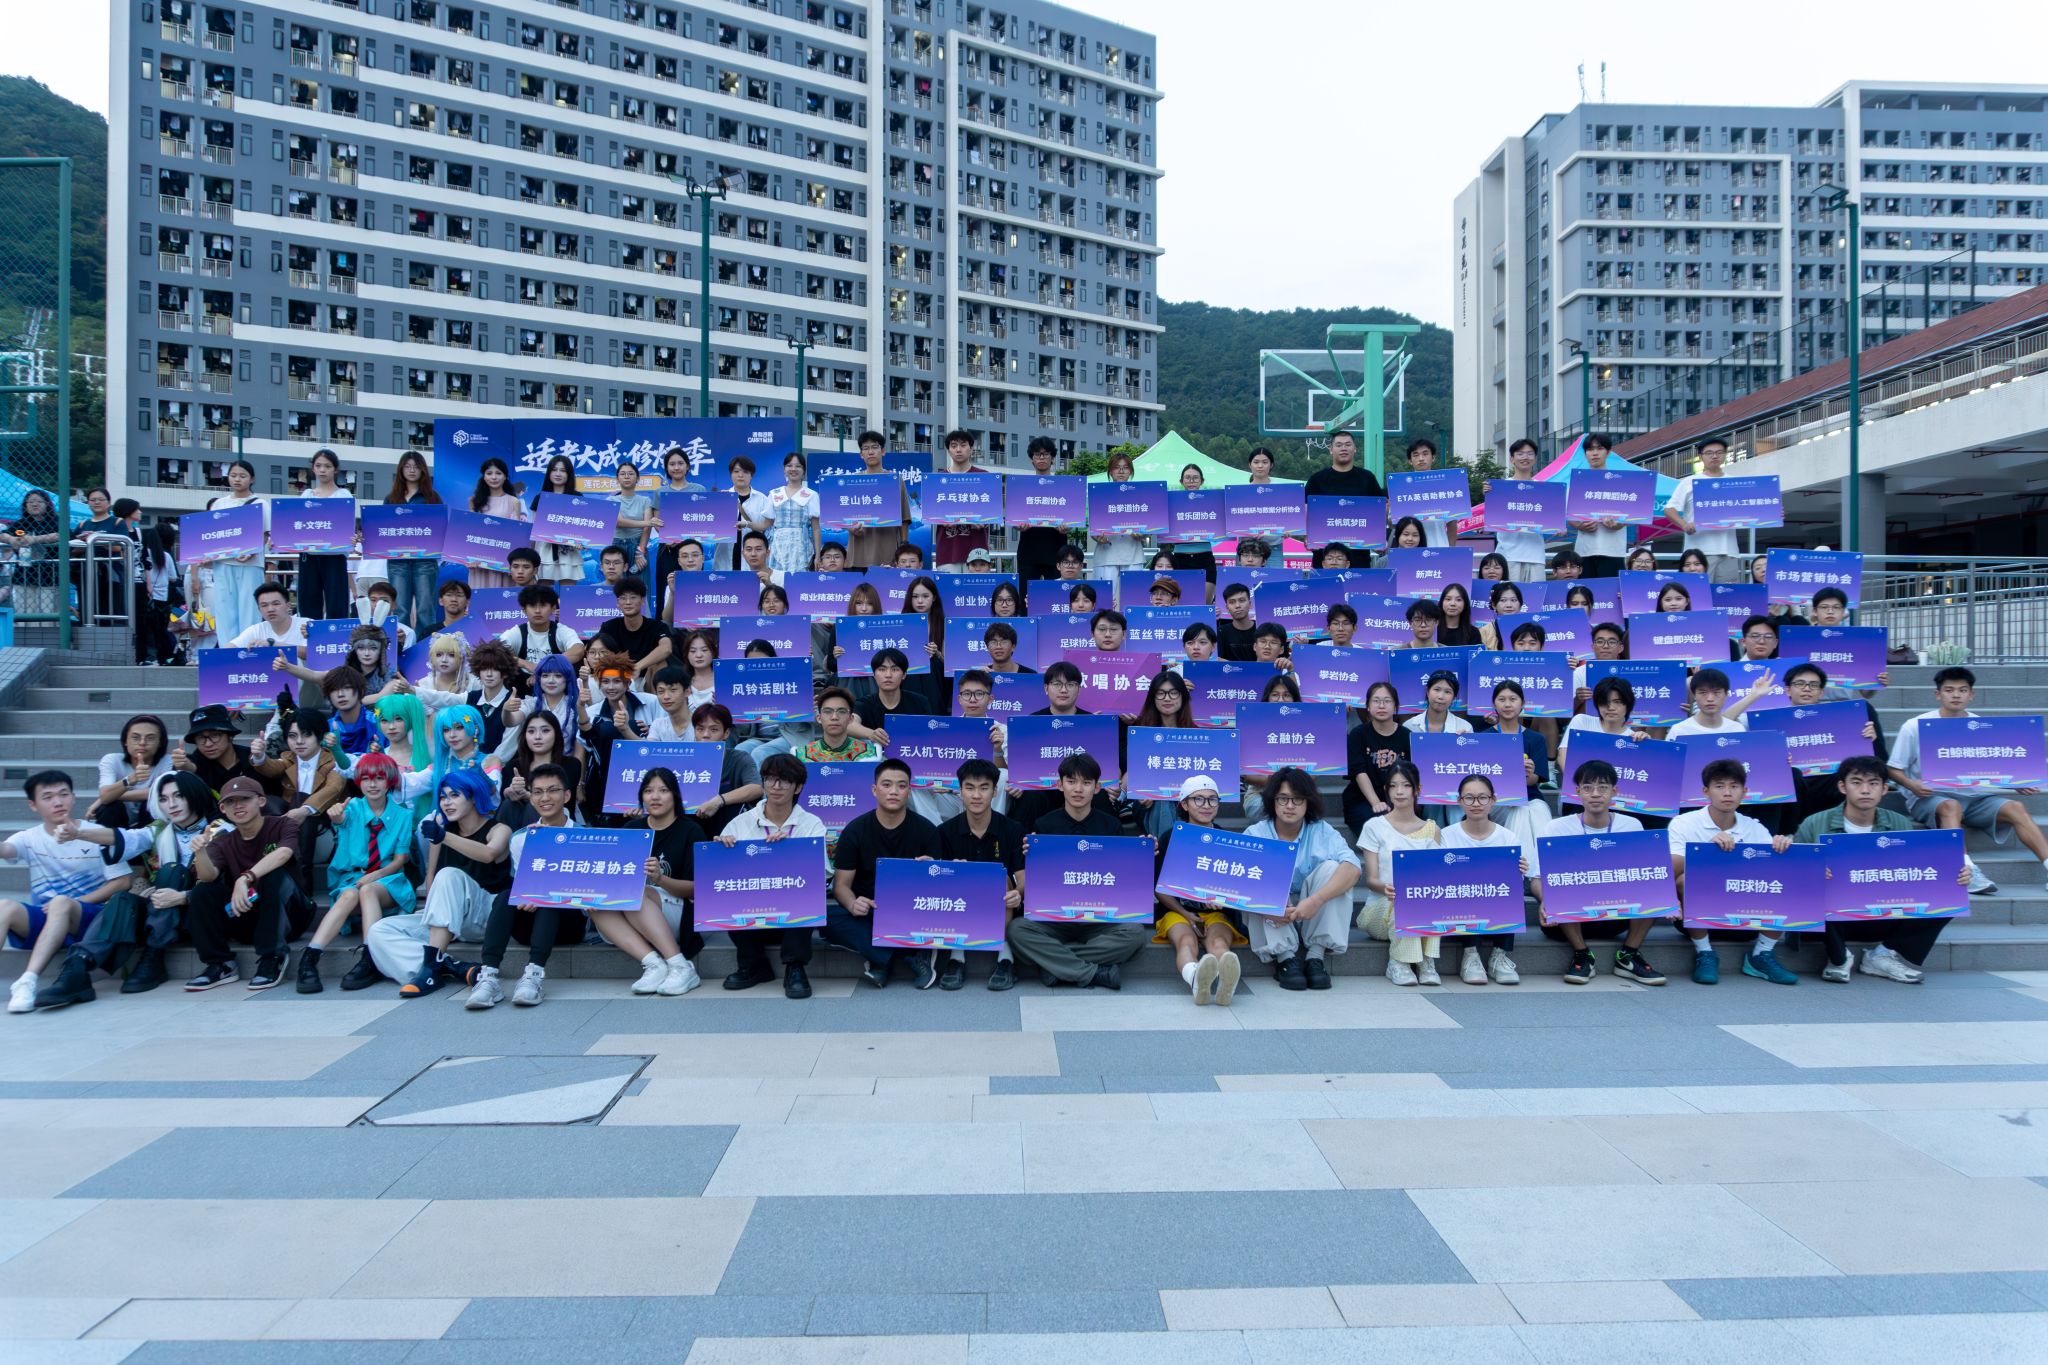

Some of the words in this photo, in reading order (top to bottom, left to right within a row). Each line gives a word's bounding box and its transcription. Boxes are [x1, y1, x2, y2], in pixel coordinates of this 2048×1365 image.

[840, 495, 882, 505] 登山协会
[937, 493, 989, 502] 乒乓球协会
[1026, 497, 1066, 505] 音乐剧协会
[1398, 490, 1463, 502] ETA英语助教协会
[1585, 491, 1637, 501] 体育舞蹈协会
[1508, 502, 1542, 511] 韩语协会
[1696, 498, 1779, 507] 电子设计与人工智能协会
[1108, 504, 1148, 513] 跆拳道协会
[547, 514, 604, 528] 经济学博弈协会
[683, 513, 714, 521] 轮滑协会
[1177, 512, 1216, 520] 管乐团协会
[1327, 518, 1366, 527] 云帆筑梦团
[202, 528, 242, 540] IOS俱乐部
[379, 527, 431, 536] 深度求索协会
[1416, 570, 1442, 578] 新声社
[1776, 571, 1852, 584] 市场营销协会
[696, 595, 738, 603] 计算机协会
[800, 593, 851, 601] 商业精英协会
[1273, 604, 1328, 616] 扬武武术协会
[860, 638, 908, 650] 街舞协会
[1060, 638, 1097, 648] 足球协会
[1653, 634, 1704, 644] 键盘即兴社
[1810, 652, 1853, 662] 星湖印社
[228, 673, 268, 684] 国术协会
[1320, 670, 1358, 682] 攀岩协会
[733, 682, 798, 695] 风铃话剧社
[1207, 689, 1257, 700] 太极拳协会
[1267, 733, 1315, 744] 金融协会
[900, 746, 977, 759] 无人机飞行协会
[1938, 746, 2026, 758] 白鲸橄榄球协会
[1148, 756, 1221, 770] 棒垒球协会
[1434, 763, 1502, 774] 社会工作协会
[808, 795, 856, 806] 英歌舞社
[532, 858, 636, 874] 春っ田动漫协会
[1197, 856, 1263, 880] 吉他协会
[1064, 871, 1115, 885] 篮球协会
[1547, 867, 1668, 886] 领宸校园直播俱乐部
[1850, 867, 1937, 883] 新质电商协会
[714, 876, 805, 892] 学生社团管理中心
[1726, 880, 1783, 893] 网球协会
[1407, 883, 1509, 899] ERP沙盘模拟协会
[914, 897, 966, 912] 龙狮协会
